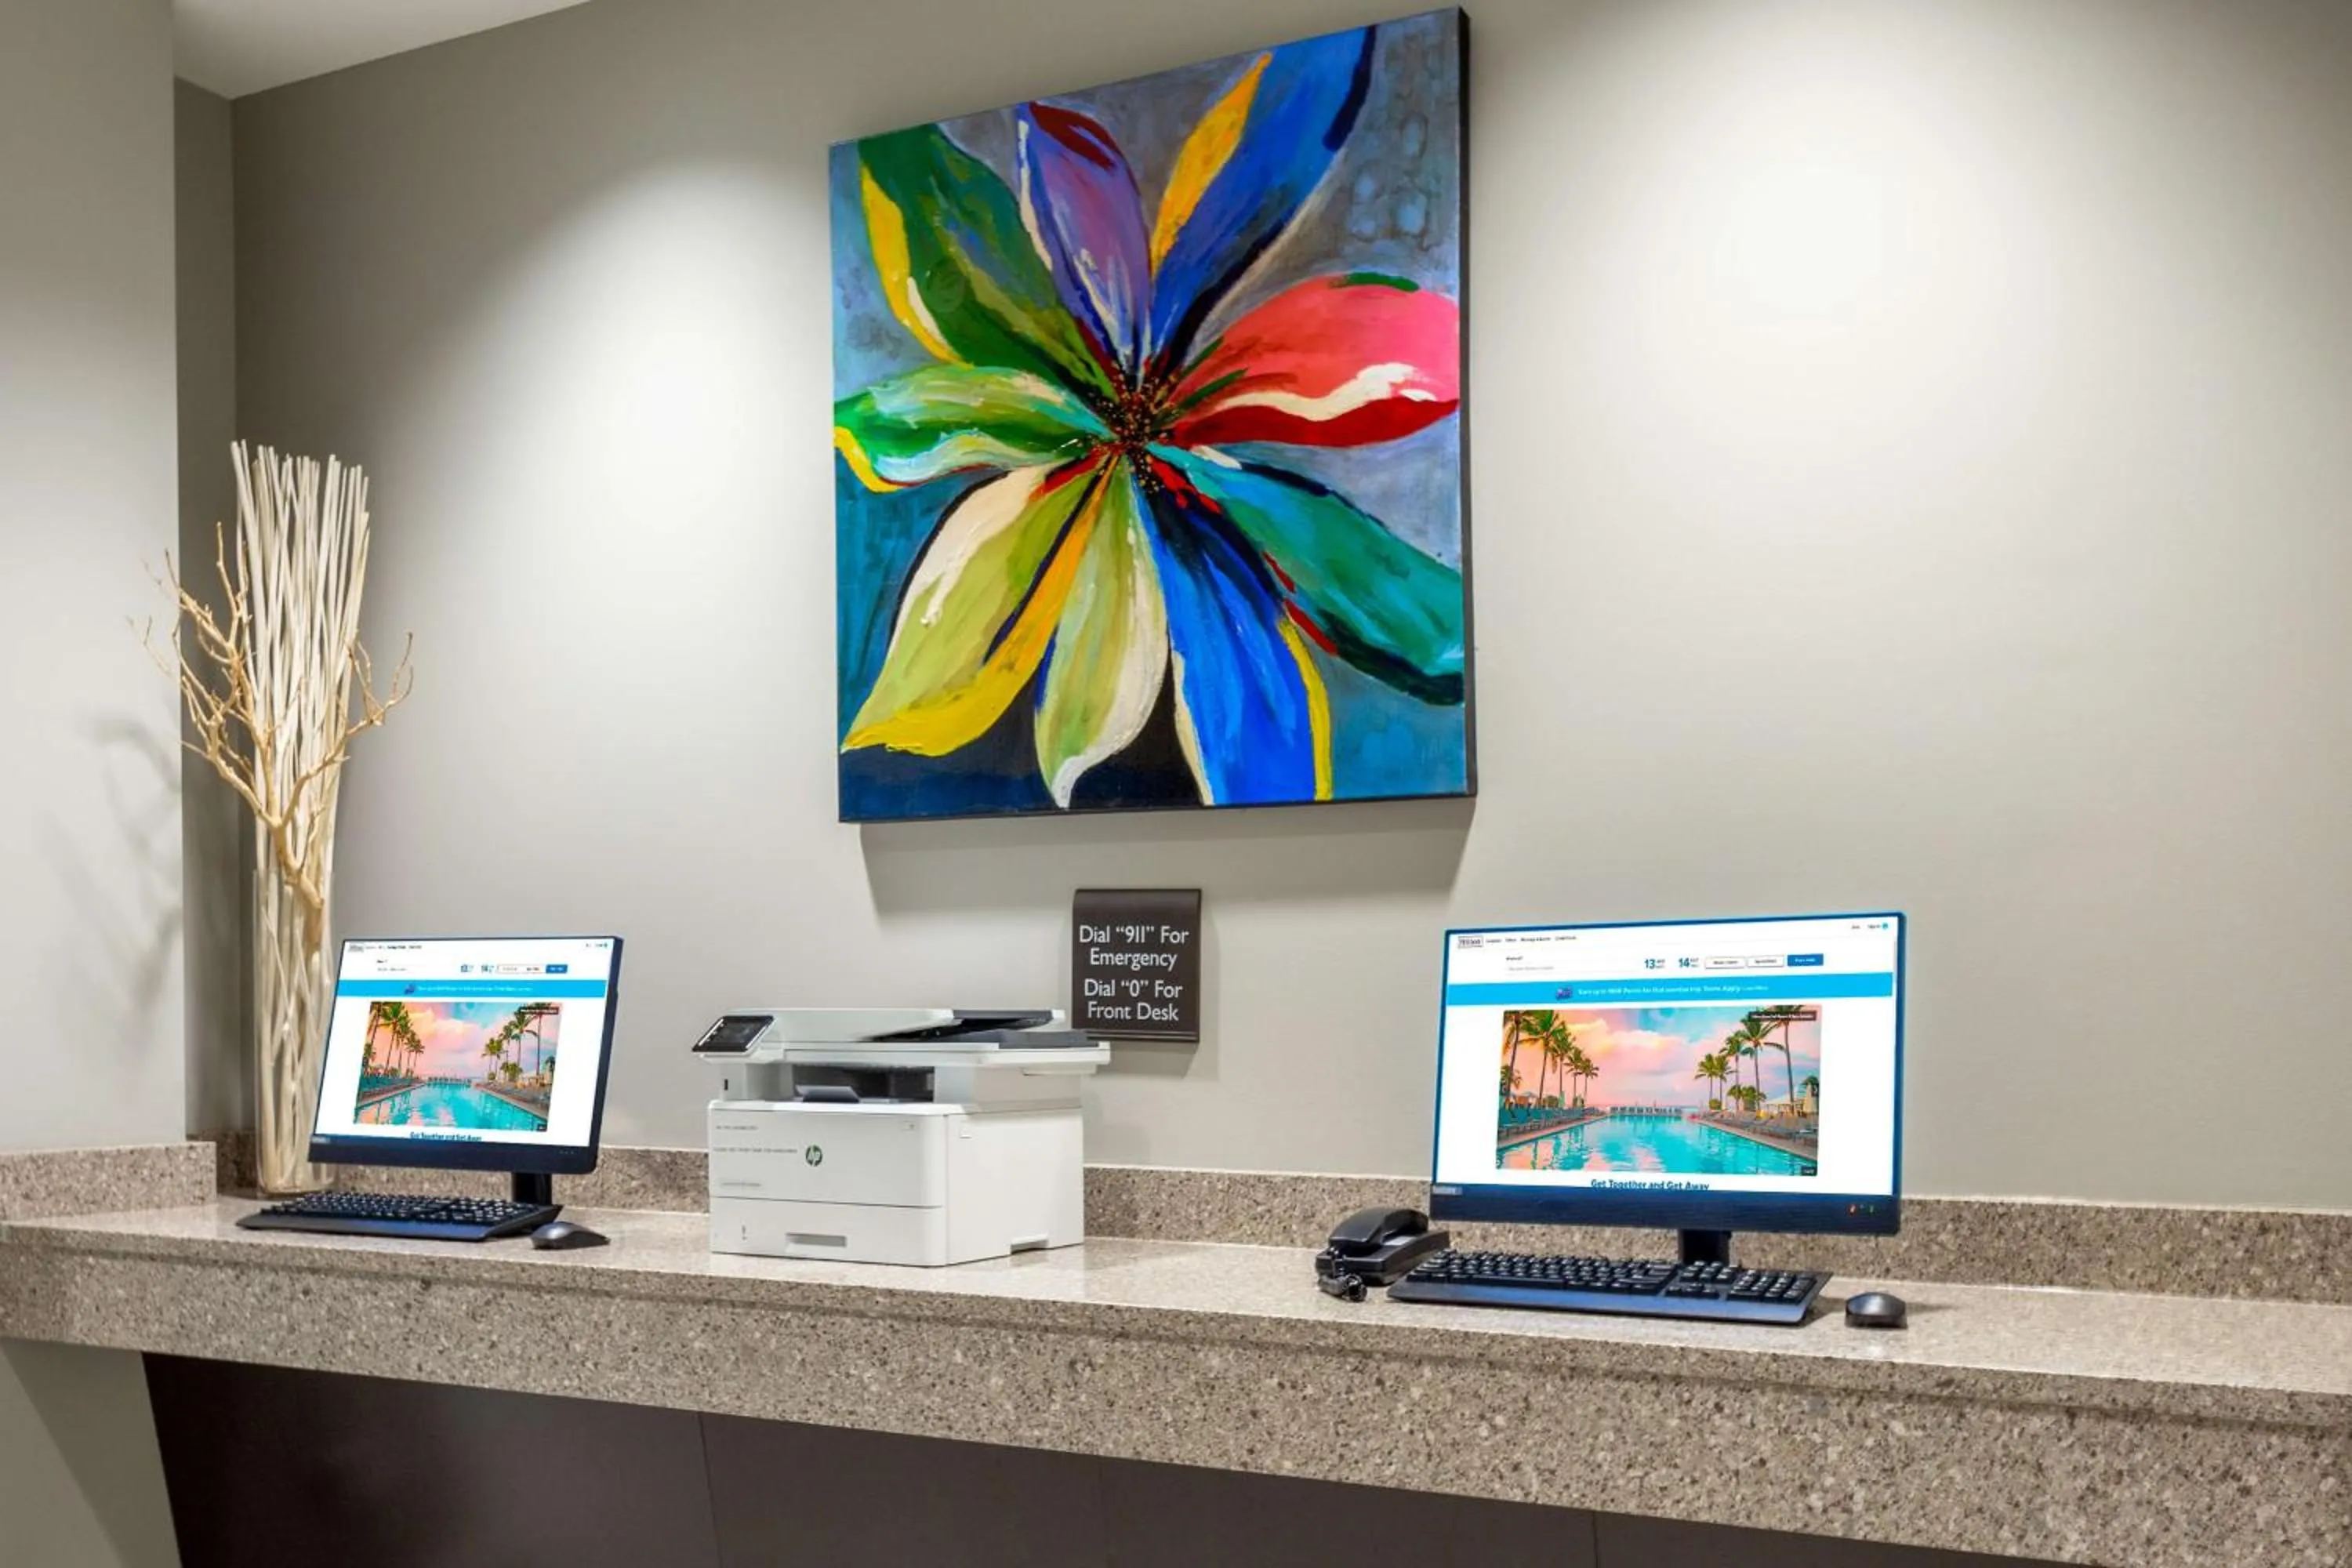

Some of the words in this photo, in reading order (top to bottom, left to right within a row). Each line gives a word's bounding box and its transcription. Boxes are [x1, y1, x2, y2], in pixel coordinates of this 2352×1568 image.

[1079, 925, 1110, 943] Dial
[1160, 925, 1189, 944] For
[1090, 948, 1178, 972] Emergency
[1084, 978, 1116, 996] Dial
[1155, 980, 1184, 998] For
[1087, 1000, 1131, 1019] Front
[1137, 1002, 1179, 1021] Desk
[1591, 1178, 1606, 1188] Get
[1608, 1179, 1647, 1189] Together
[1649, 1180, 1665, 1189] and
[1666, 1181, 1682, 1190] Get
[1685, 1181, 1710, 1191] Away
